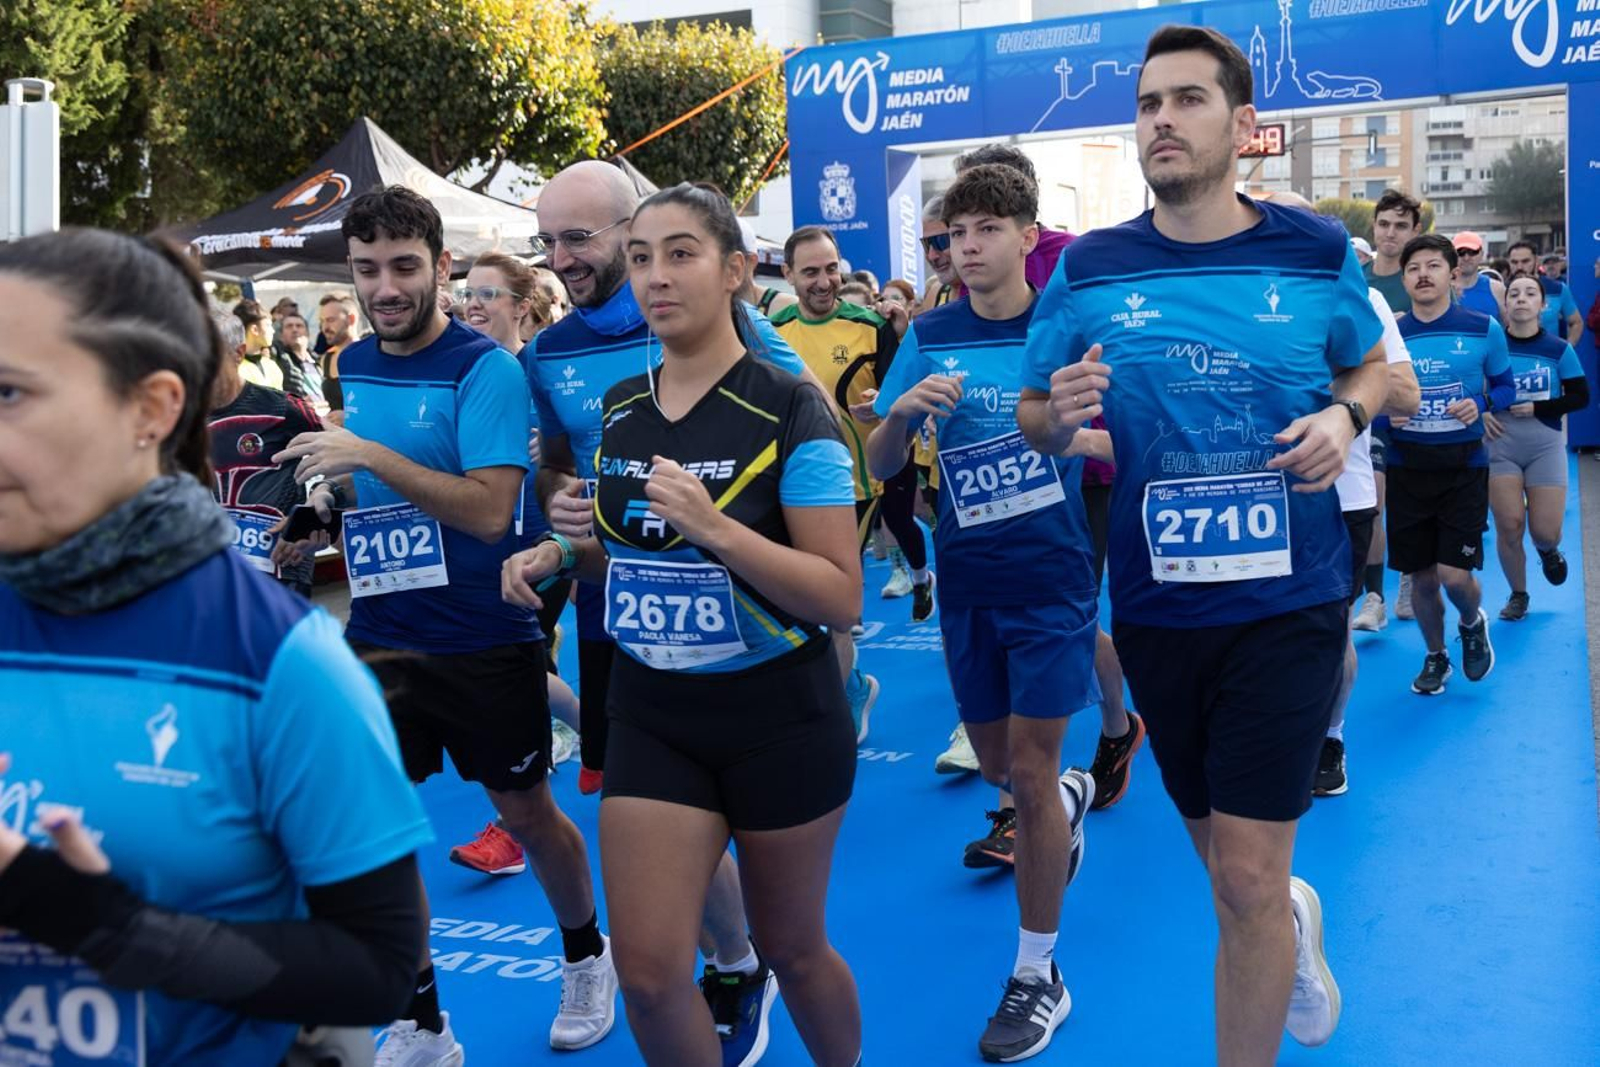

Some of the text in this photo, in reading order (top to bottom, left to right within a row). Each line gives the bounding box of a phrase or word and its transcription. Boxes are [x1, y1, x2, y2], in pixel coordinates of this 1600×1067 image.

[886, 85, 970, 109] MARATÓN
[889, 68, 944, 88] MEDIA
[880, 111, 923, 132] JAÉN
[955, 450, 1047, 497] 2052
[1155, 503, 1277, 544] 2710
[350, 525, 434, 565] 2102
[616, 591, 725, 632] 2678
[429, 917, 556, 946] EDIA
[0, 984, 120, 1059] 40
